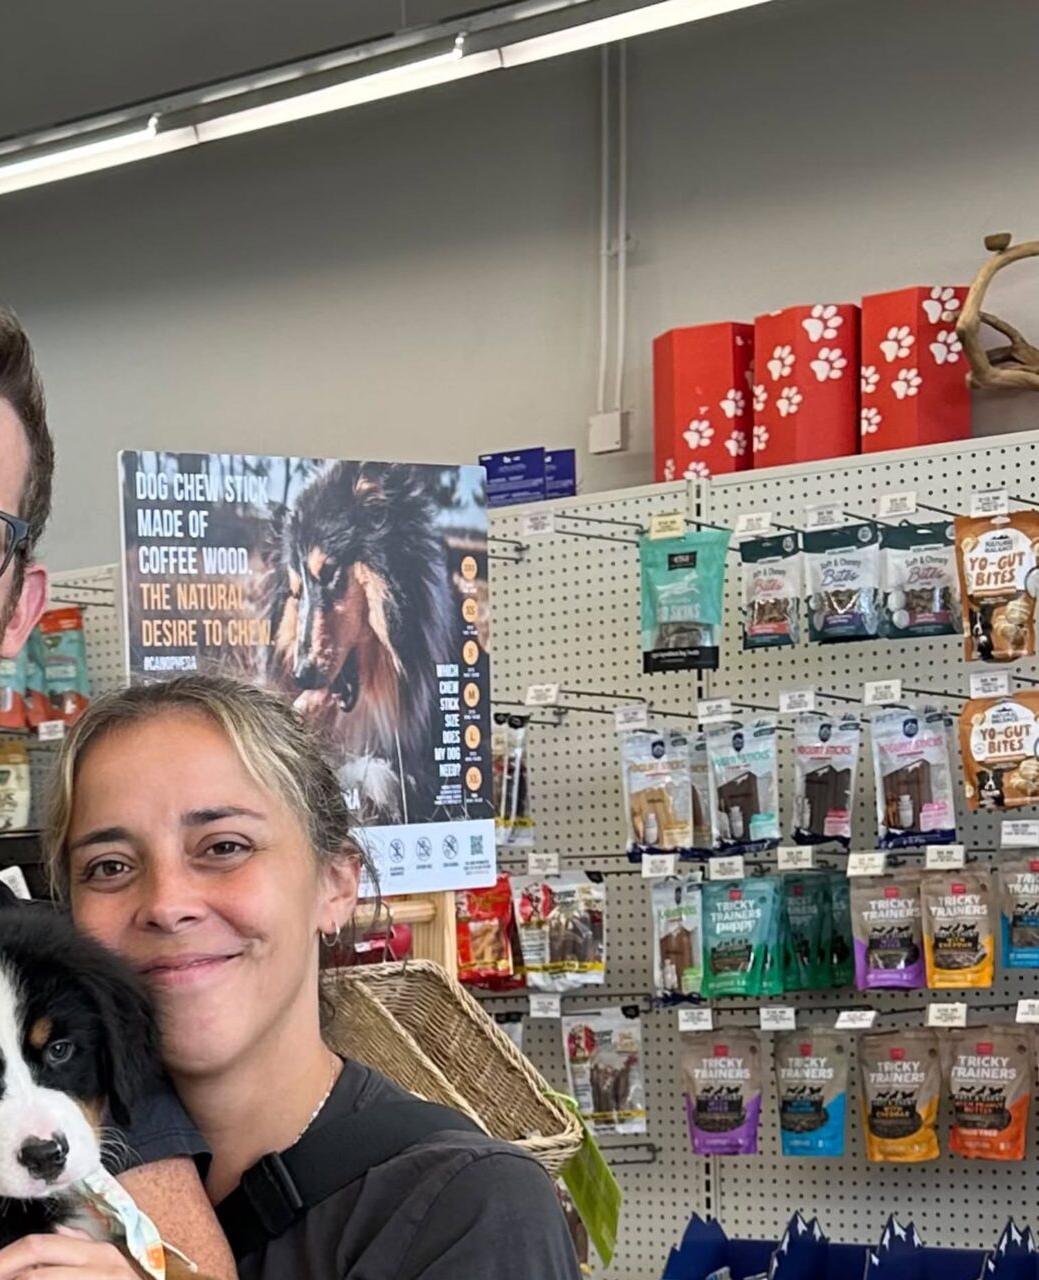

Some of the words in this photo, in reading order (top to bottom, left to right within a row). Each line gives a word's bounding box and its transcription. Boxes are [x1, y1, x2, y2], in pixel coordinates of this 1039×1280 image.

[136, 472, 168, 500] DOG
[174, 473, 223, 502] CHEW
[225, 475, 269, 503] STICK
[137, 509, 184, 537] MADE
[189, 511, 209, 537] OF
[139, 546, 198, 574] COFFEE
[202, 547, 253, 575] WOOD.
[969, 552, 1026, 571] YO-GUT
[976, 569, 1015, 586] BITES
[140, 583, 171, 610] THE
[176, 583, 246, 610] NATURAL
[142, 620, 197, 647] DESIRE
[202, 620, 223, 646] TO
[228, 619, 275, 647] CHEW.
[468, 648, 474, 658] S
[468, 690, 475, 699] M
[440, 697, 460, 710] STICK
[470, 732, 475, 741] L
[980, 724, 1031, 742] YO-GUT
[988, 738, 1024, 754] BITES
[447, 747, 460, 760] DOG
[716, 900, 754, 912] TRICKY
[869, 899, 914, 911] TRICKY
[938, 895, 980, 906] TRICKY
[710, 909, 761, 922] TRAINERS
[862, 908, 921, 921] TRAINERS
[930, 905, 987, 918] TRAINERS
[716, 920, 756, 934] puppy
[702, 1057, 743, 1069] TRICKY
[788, 1057, 828, 1069] TRICKY
[877, 1061, 920, 1072] TRICKY
[958, 1056, 1009, 1067] TRICKY
[694, 1068, 751, 1080] TRAINERS
[781, 1068, 834, 1080] TRAINERS
[870, 1072, 925, 1083] TRAINERS
[952, 1067, 1017, 1080] TRAINERS
